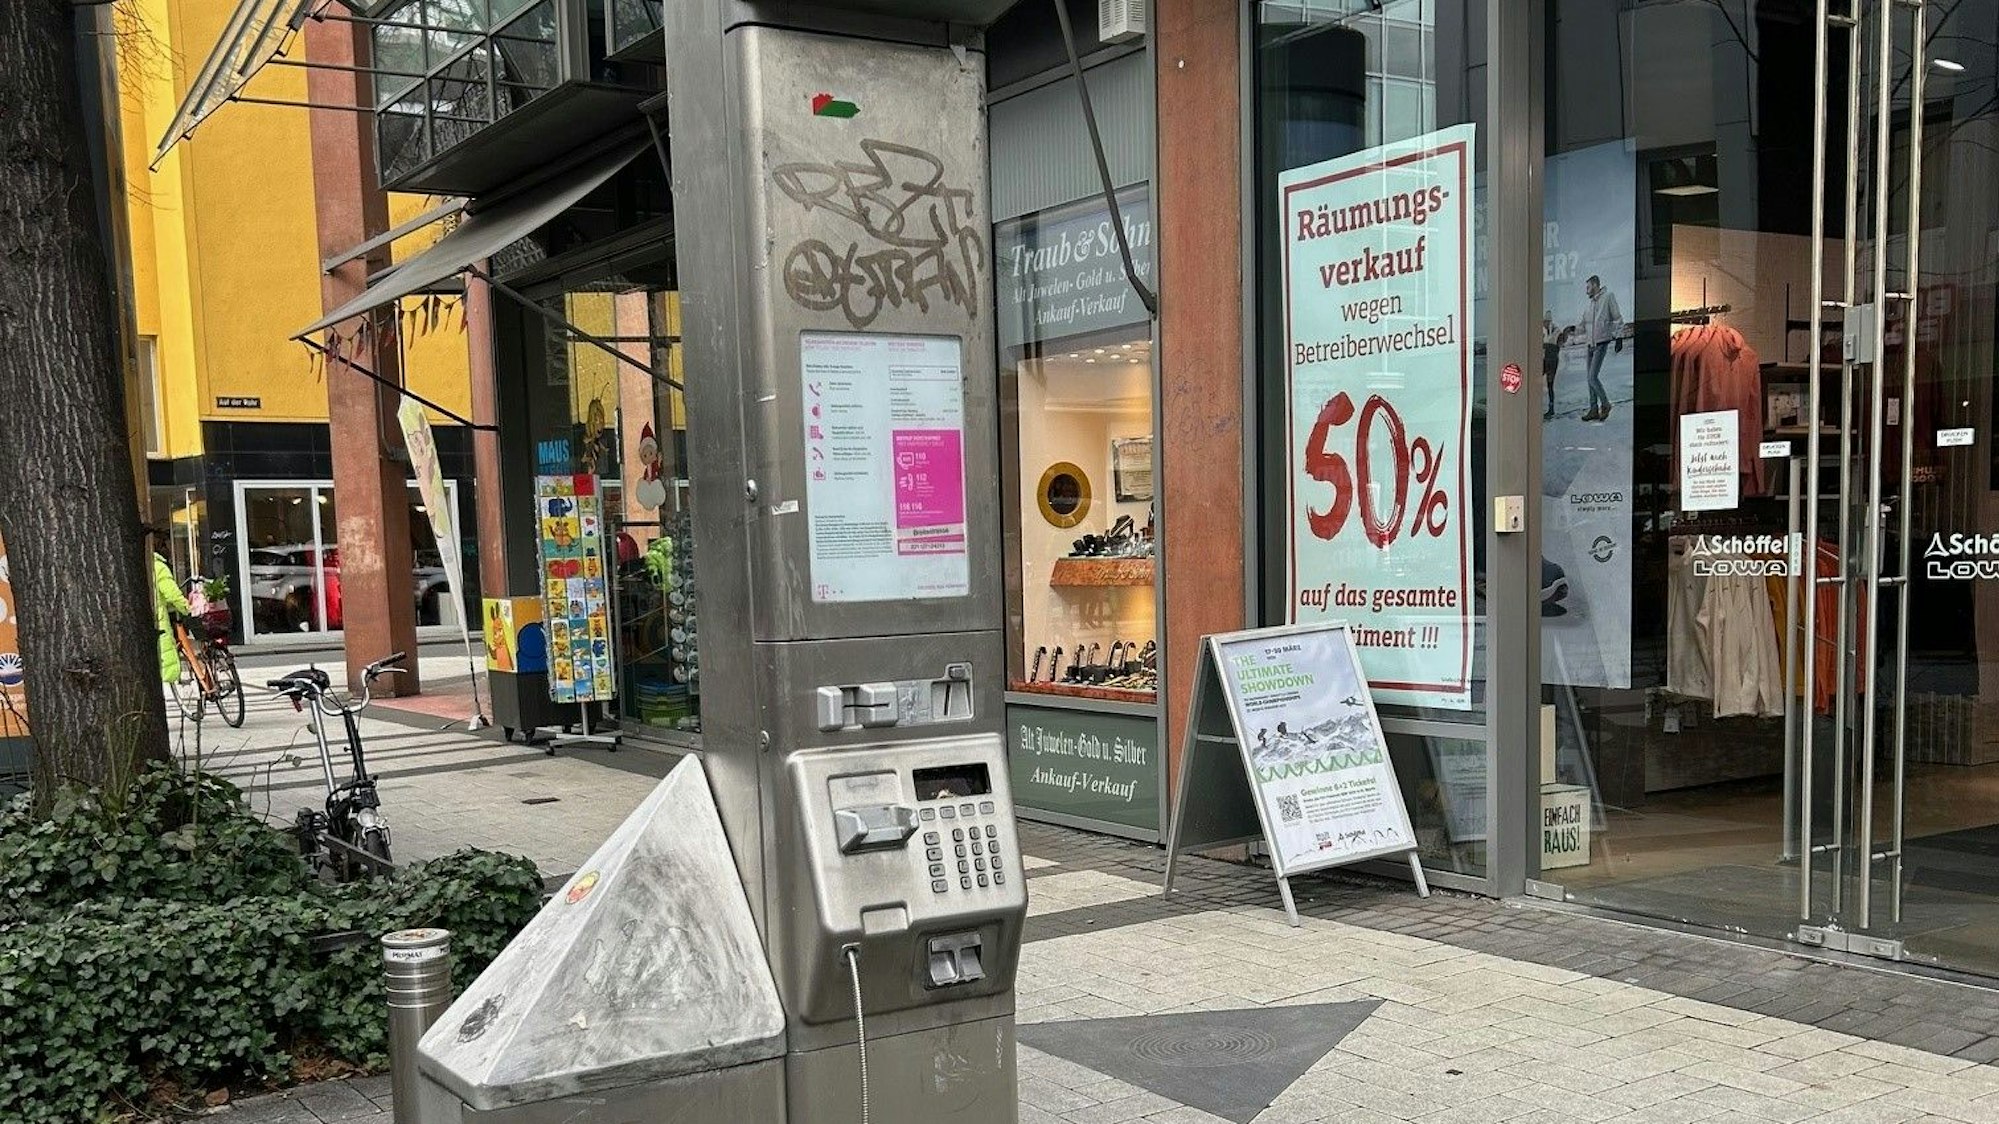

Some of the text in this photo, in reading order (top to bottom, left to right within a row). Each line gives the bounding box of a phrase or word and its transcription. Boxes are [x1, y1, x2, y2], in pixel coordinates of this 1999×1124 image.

[1297, 184, 1450, 242] Räumungs-
[1012, 231, 1072, 278] Traub
[1074, 229, 1096, 263] &
[1319, 235, 1426, 289] verkauf
[1075, 268, 1103, 291] Gold
[1105, 271, 1116, 283] u.
[1035, 288, 1129, 325] Ankauf-Verkauf
[1341, 294, 1403, 324] wegen
[1294, 314, 1455, 366] Betreiberwechsel
[1502, 373, 1520, 383] STOP
[538, 439, 570, 465] MAUS
[1305, 391, 1449, 550] 50%
[1571, 492, 1623, 504] LOWA
[1711, 534, 1789, 554] Schöffel
[1693, 560, 1788, 577] LOWA
[1300, 583, 1457, 620] auf das gesamte
[1421, 626, 1440, 649] !!!
[1232, 655, 1256, 667] THE
[1236, 663, 1293, 681] ULTIMATE
[1240, 674, 1314, 694] SHOWDOWN
[1113, 736, 1147, 765] Silber
[1030, 766, 1137, 802] Ankauf-Verkauf
[1301, 784, 1333, 797] Gewinne
[1544, 804, 1581, 827] EINFACH
[1544, 825, 1580, 854] RAUS!
